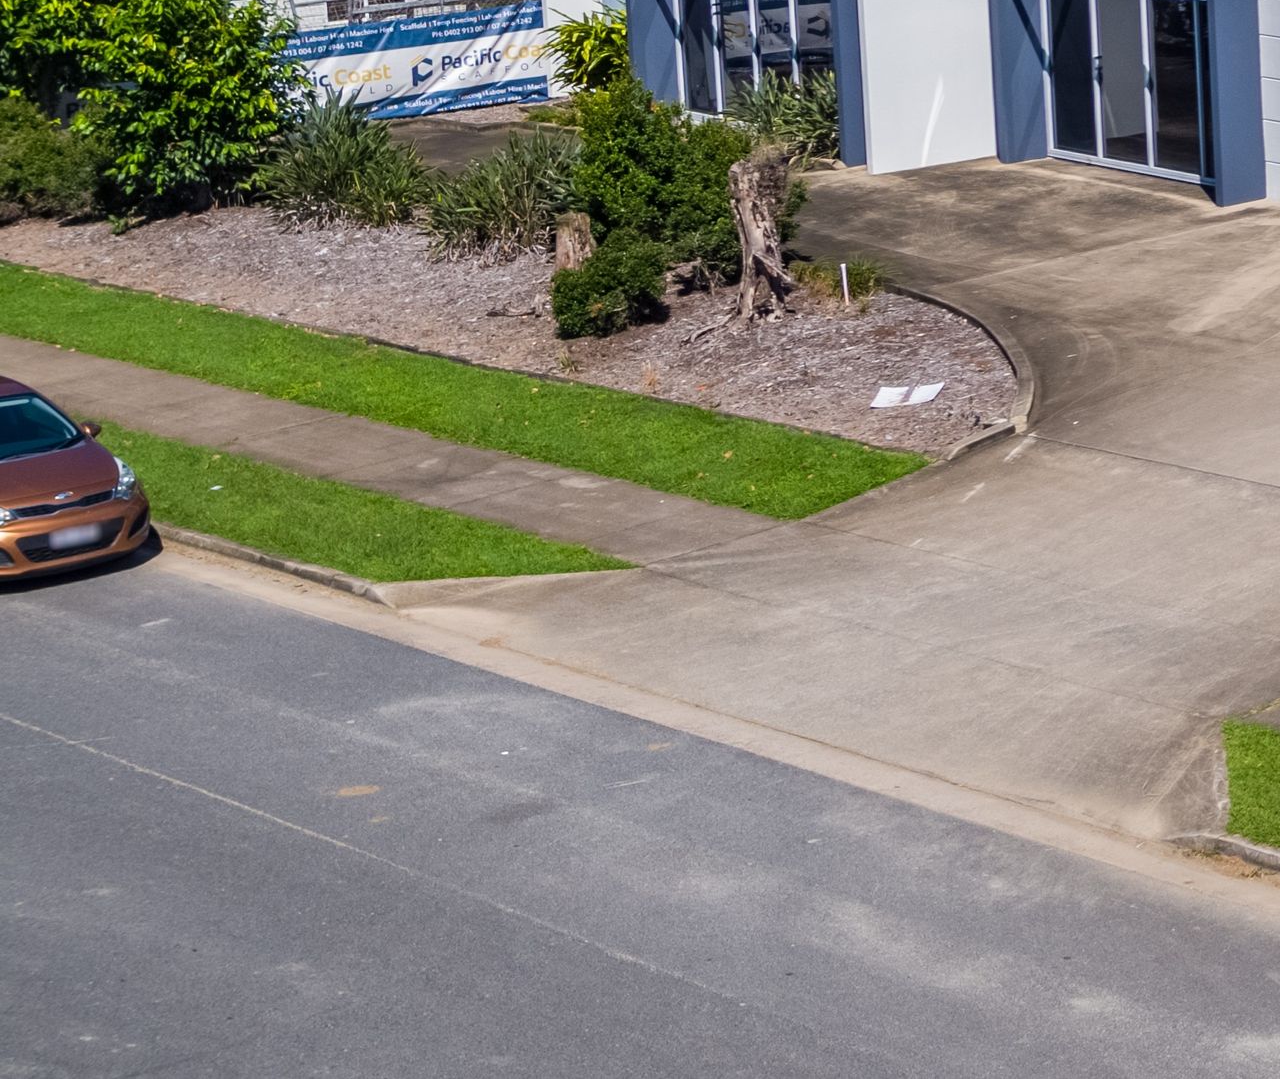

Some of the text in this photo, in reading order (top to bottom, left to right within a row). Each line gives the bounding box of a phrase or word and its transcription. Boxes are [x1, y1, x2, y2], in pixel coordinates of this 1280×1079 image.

[349, 29, 378, 38] Machine
[444, 28, 461, 36] 0402
[284, 49, 297, 57] 913
[298, 47, 312, 55] 004
[317, 45, 327, 53] 07
[346, 41, 363, 49] 1242
[441, 42, 543, 71] Pacific Coa
[334, 64, 392, 86] Coast
[441, 61, 543, 81] SCAFFOL
